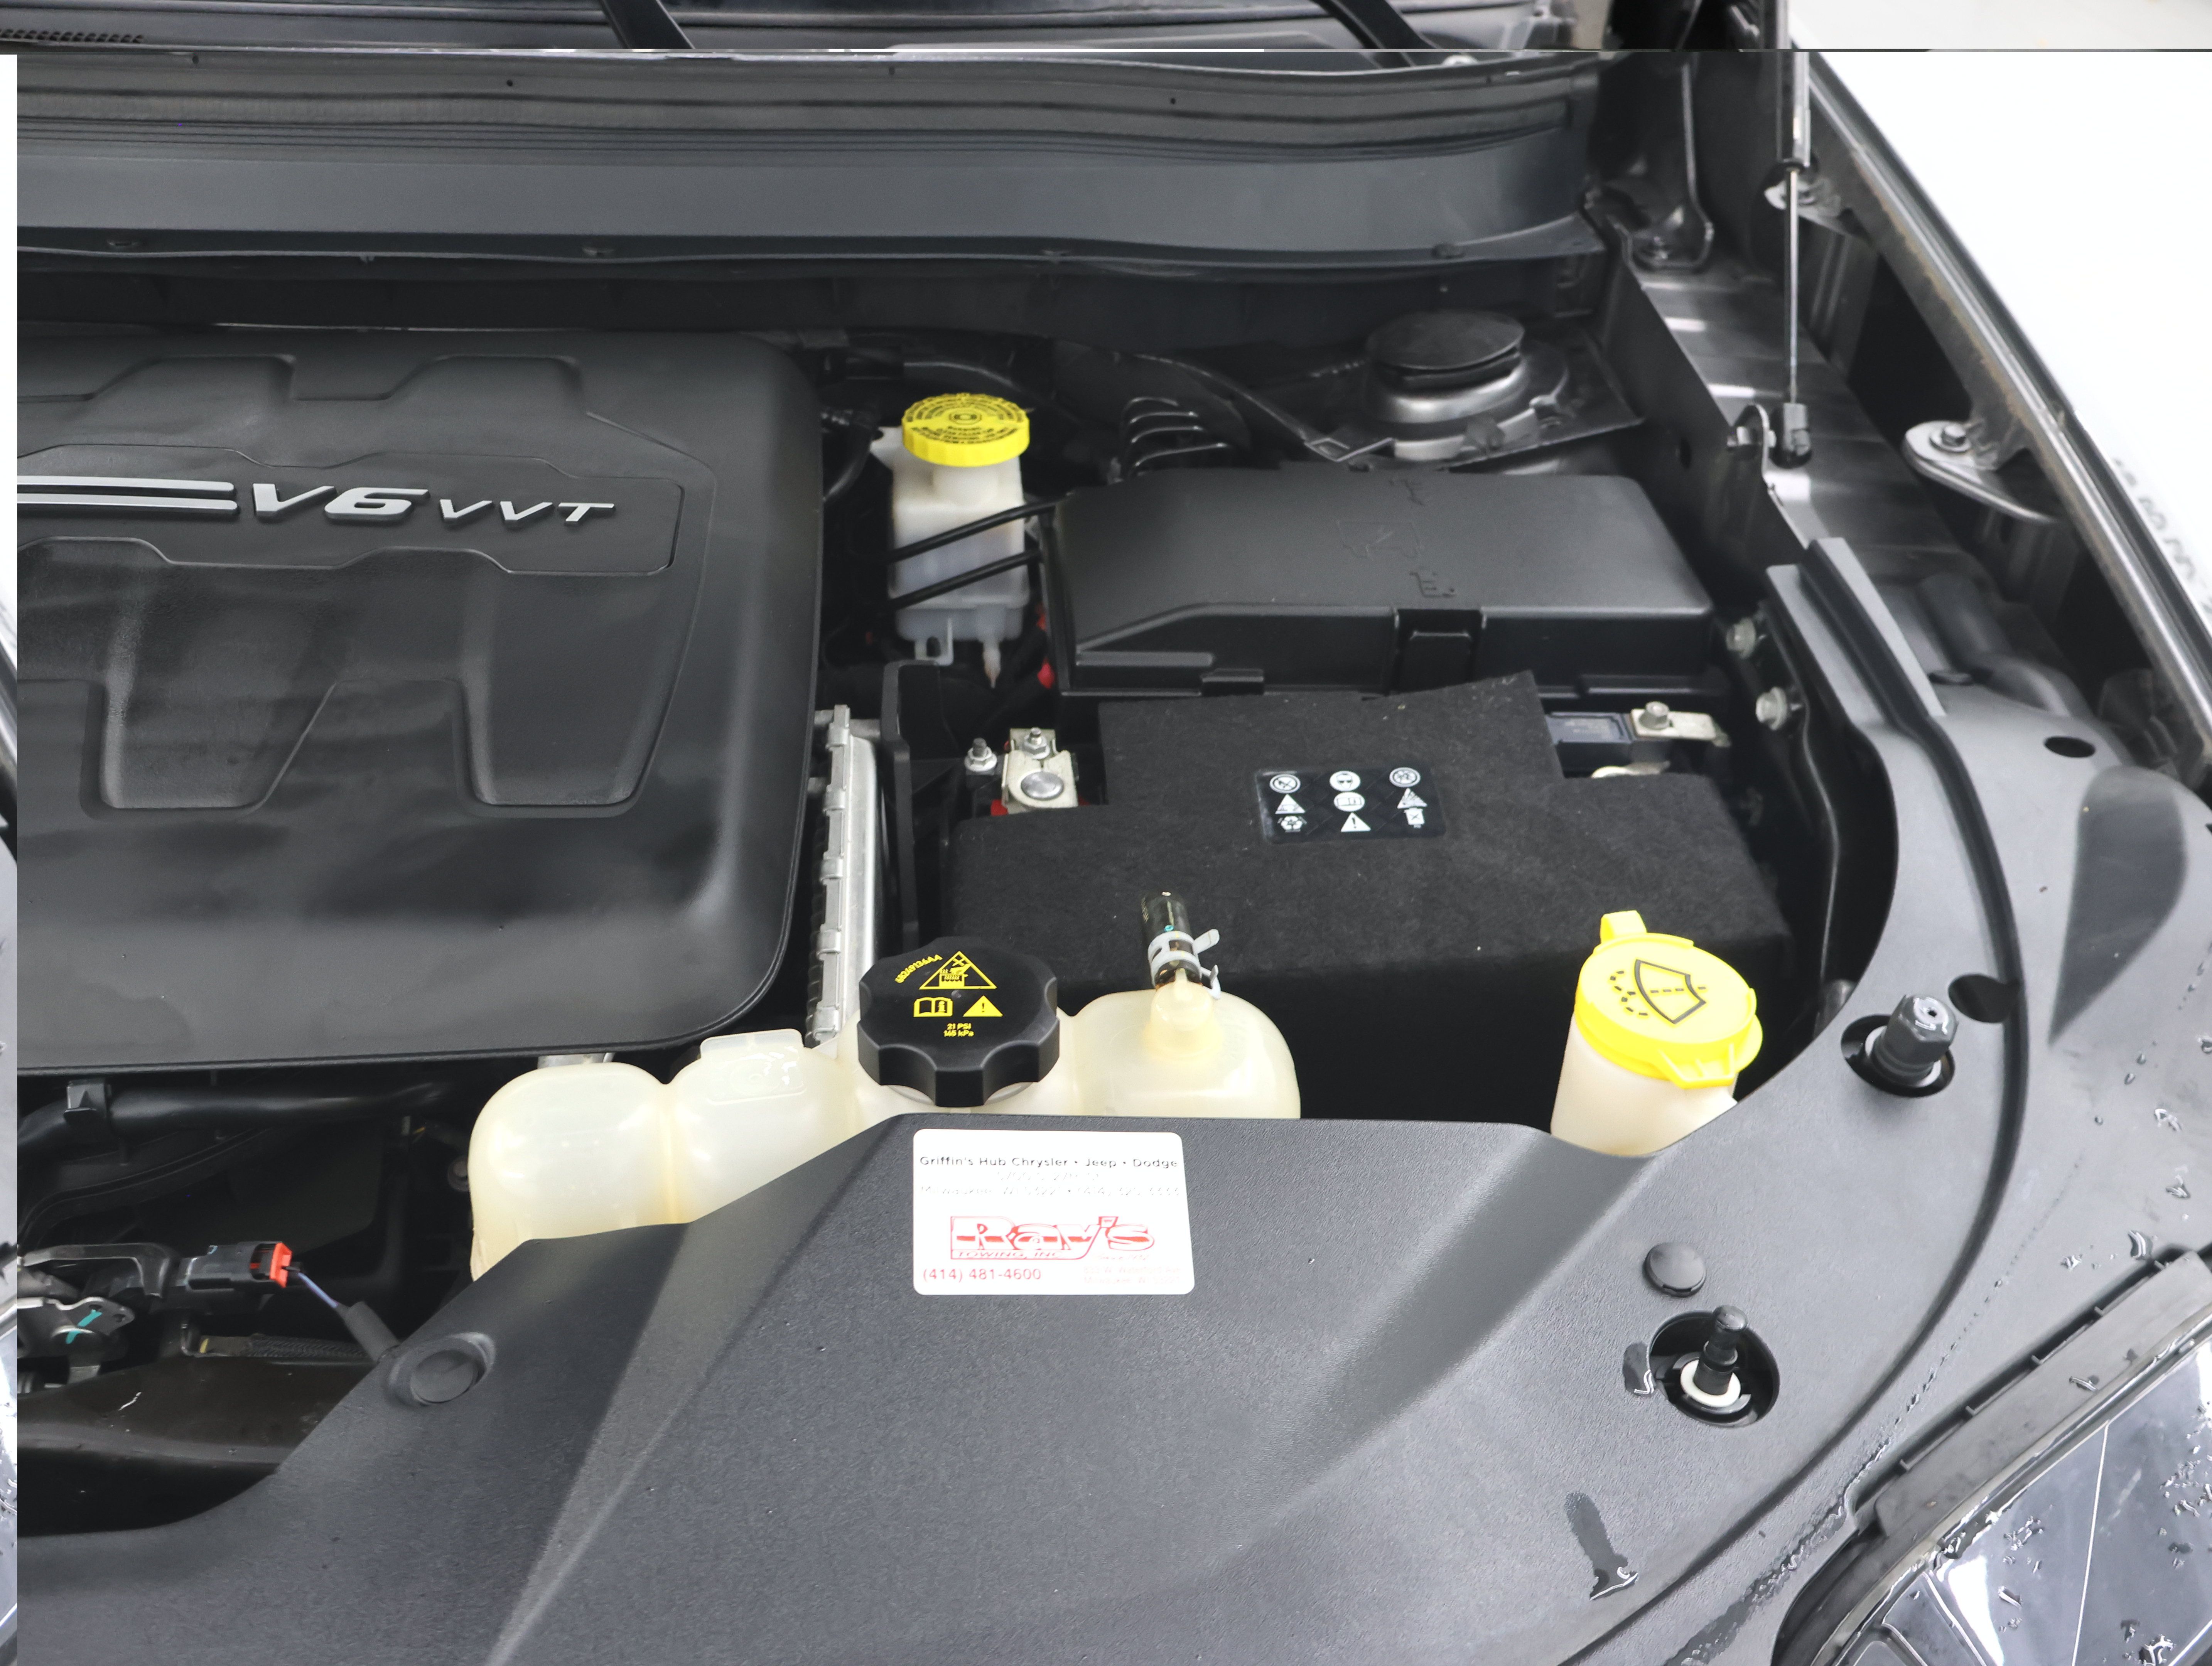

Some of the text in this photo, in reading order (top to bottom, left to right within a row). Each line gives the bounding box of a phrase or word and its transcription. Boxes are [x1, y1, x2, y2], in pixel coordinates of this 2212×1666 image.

[252, 483, 615, 522] V6 VVT
[920, 1156, 1177, 1169] Griffin's Hub Chrysler Jeep Dodge
[950, 1216, 1156, 1260] Ray's
[923, 1268, 1042, 1283] (414) 481-4600
